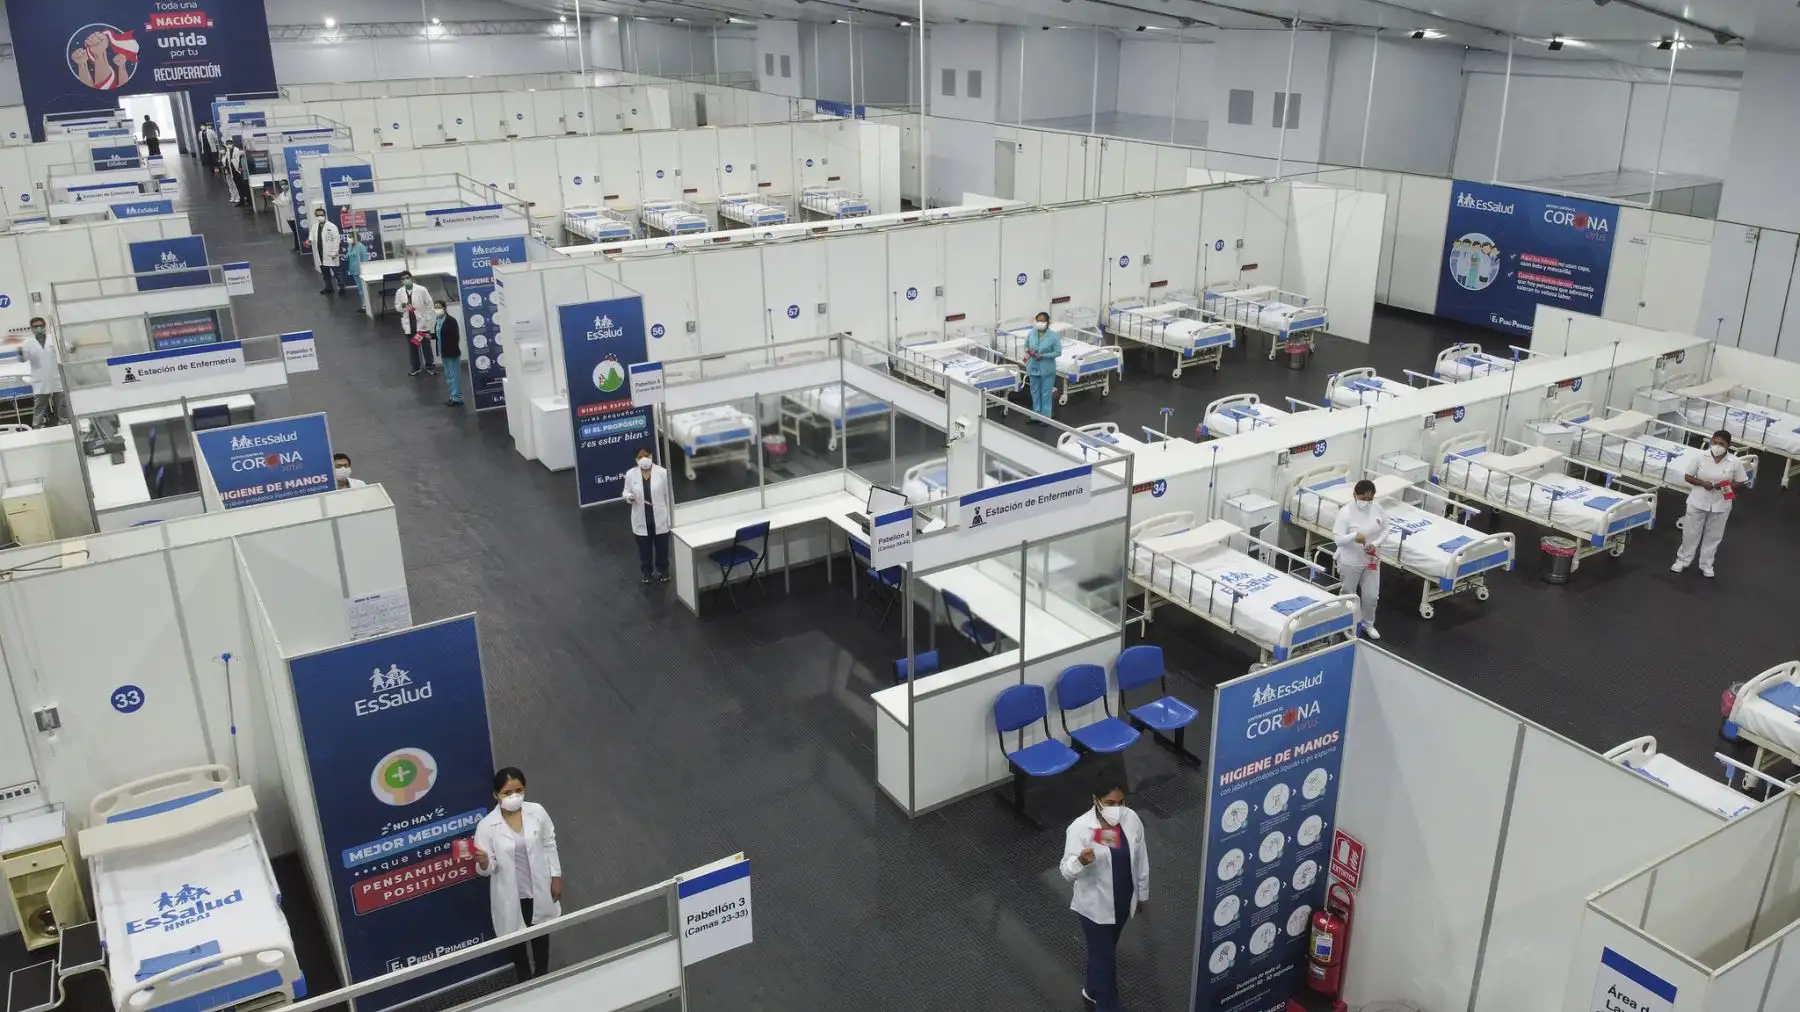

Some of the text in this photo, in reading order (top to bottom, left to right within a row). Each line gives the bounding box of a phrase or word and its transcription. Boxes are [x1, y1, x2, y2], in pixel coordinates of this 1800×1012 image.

[155, 1, 198, 11] Toda una
[155, 13, 202, 27] NACIÓN
[157, 31, 207, 48] unida
[170, 48, 199, 60] por tu
[153, 62, 222, 82] RECUPERACIÓN
[1476, 199, 1515, 215] EsSalud
[1216, 242, 1224, 250] 61
[154, 261, 188, 271] EsSalud
[788, 307, 799, 316] 57
[586, 326, 623, 341] EsSalud
[651, 327, 664, 335] 56
[137, 363, 176, 377] Estación
[190, 356, 237, 369] Enfermería
[1572, 378, 1582, 389] 37
[1454, 408, 1464, 420] 36
[254, 430, 298, 447] EsSalud
[586, 431, 644, 448] es estar bien
[1314, 442, 1326, 454] 35
[266, 482, 283, 492] DE
[284, 474, 329, 489] MANOS
[1152, 481, 1165, 494] 34
[985, 486, 1084, 517] Estación de Enfermería
[1276, 670, 1323, 699] EsSalud
[114, 690, 141, 709] 33
[354, 681, 433, 717] EsSalud
[1219, 730, 1340, 786] HIGIENE DE MANOS
[1220, 788, 1232, 797] con
[1305, 755, 1314, 764] en
[392, 812, 434, 832] NO HAY
[348, 810, 485, 863] MEJOR MEDICINA
[1331, 863, 1357, 883] EXTINTOR
[383, 866, 469, 900] POSITIVOS
[126, 889, 244, 935] EsSalud
[686, 897, 746, 925] Pabellón 3
[684, 908, 749, 938] (Camas 23-33)
[435, 937, 480, 958] PRIMERO
[1608, 984, 1637, 1010] Área
